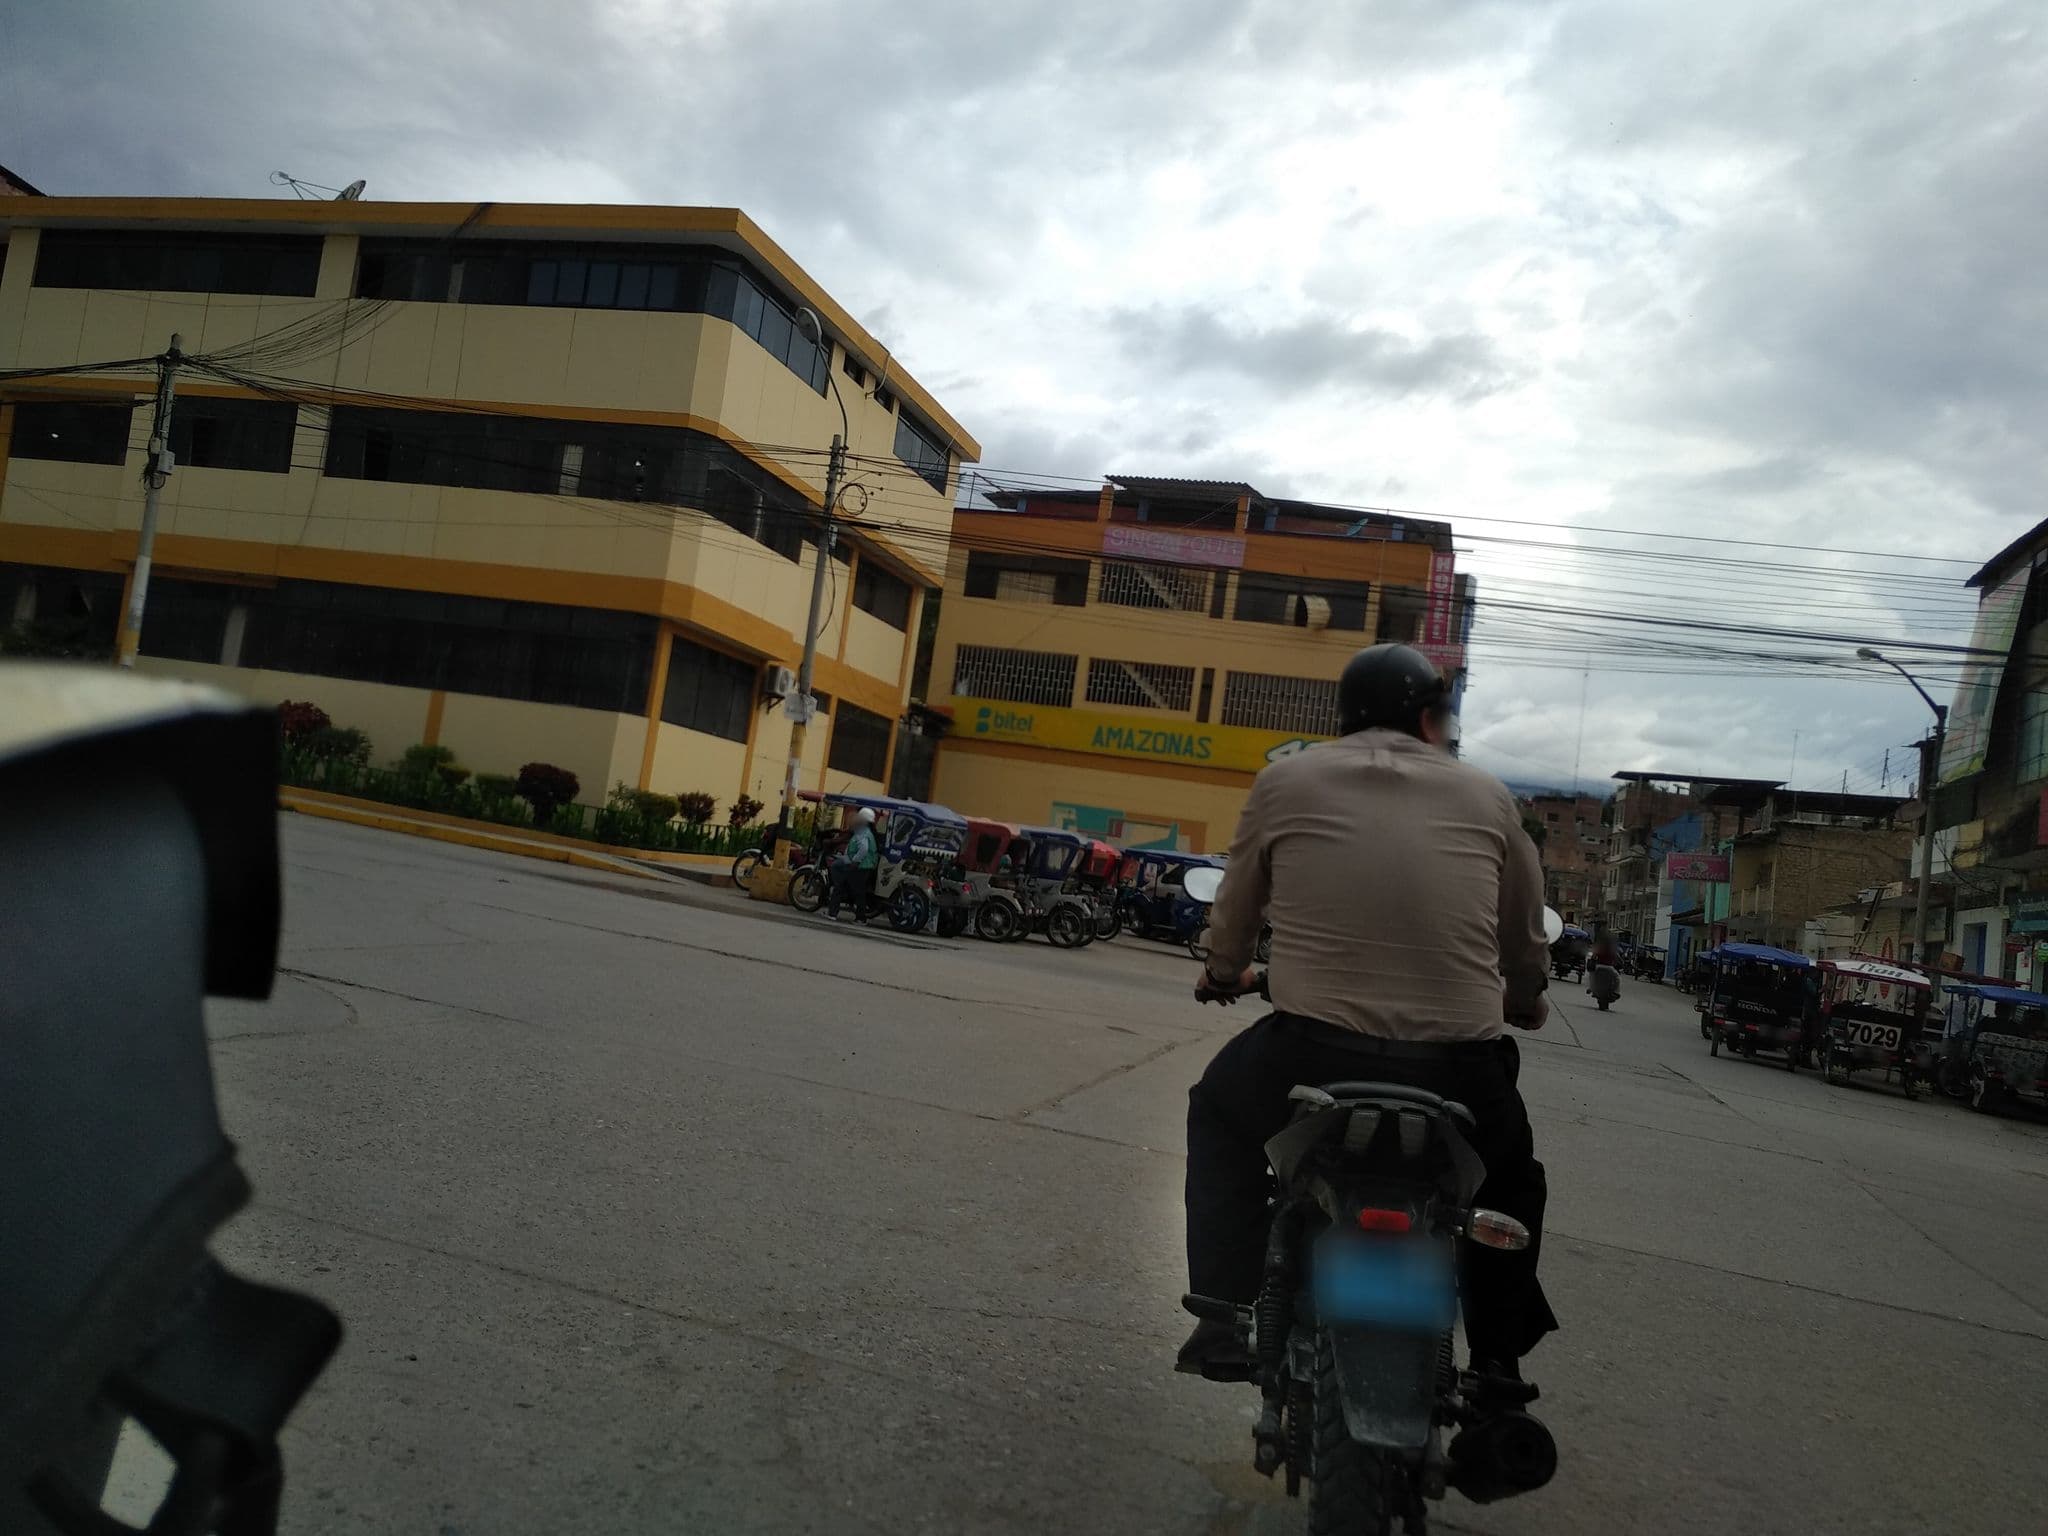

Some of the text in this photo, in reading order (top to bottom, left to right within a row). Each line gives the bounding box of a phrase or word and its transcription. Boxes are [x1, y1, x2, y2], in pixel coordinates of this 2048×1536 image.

[993, 711, 1033, 732] bitel
[1091, 725, 1212, 759] AMAZONAS
[1737, 1001, 1778, 1015] HONDA
[1848, 1022, 1898, 1048] 7029
